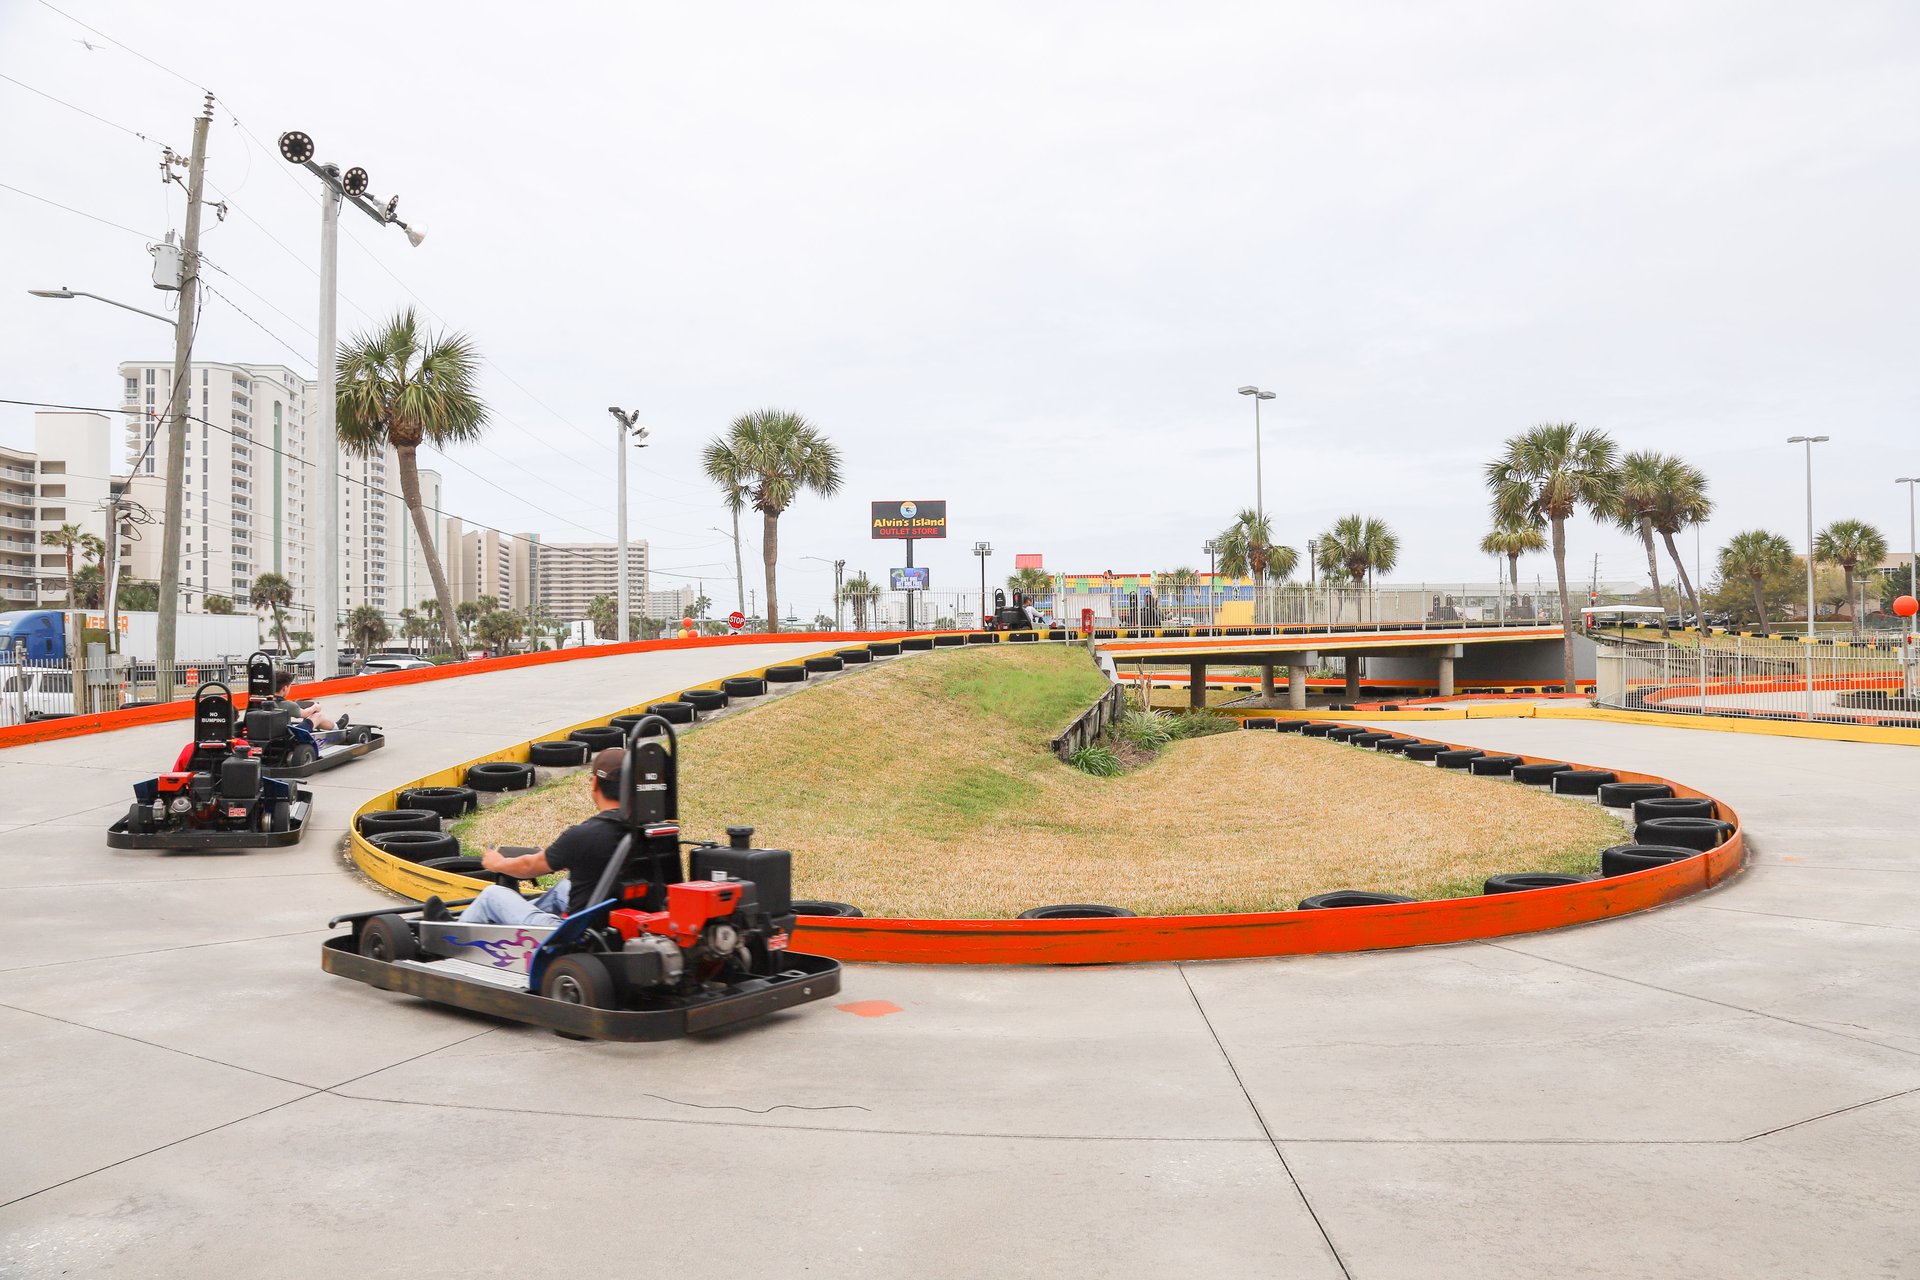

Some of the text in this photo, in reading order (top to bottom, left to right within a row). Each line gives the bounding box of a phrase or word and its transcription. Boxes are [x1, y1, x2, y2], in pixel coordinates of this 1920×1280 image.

[873, 518, 945, 528] Alvin's Island
[730, 616, 745, 624] STOP
[636, 783, 667, 791] BUMPING
